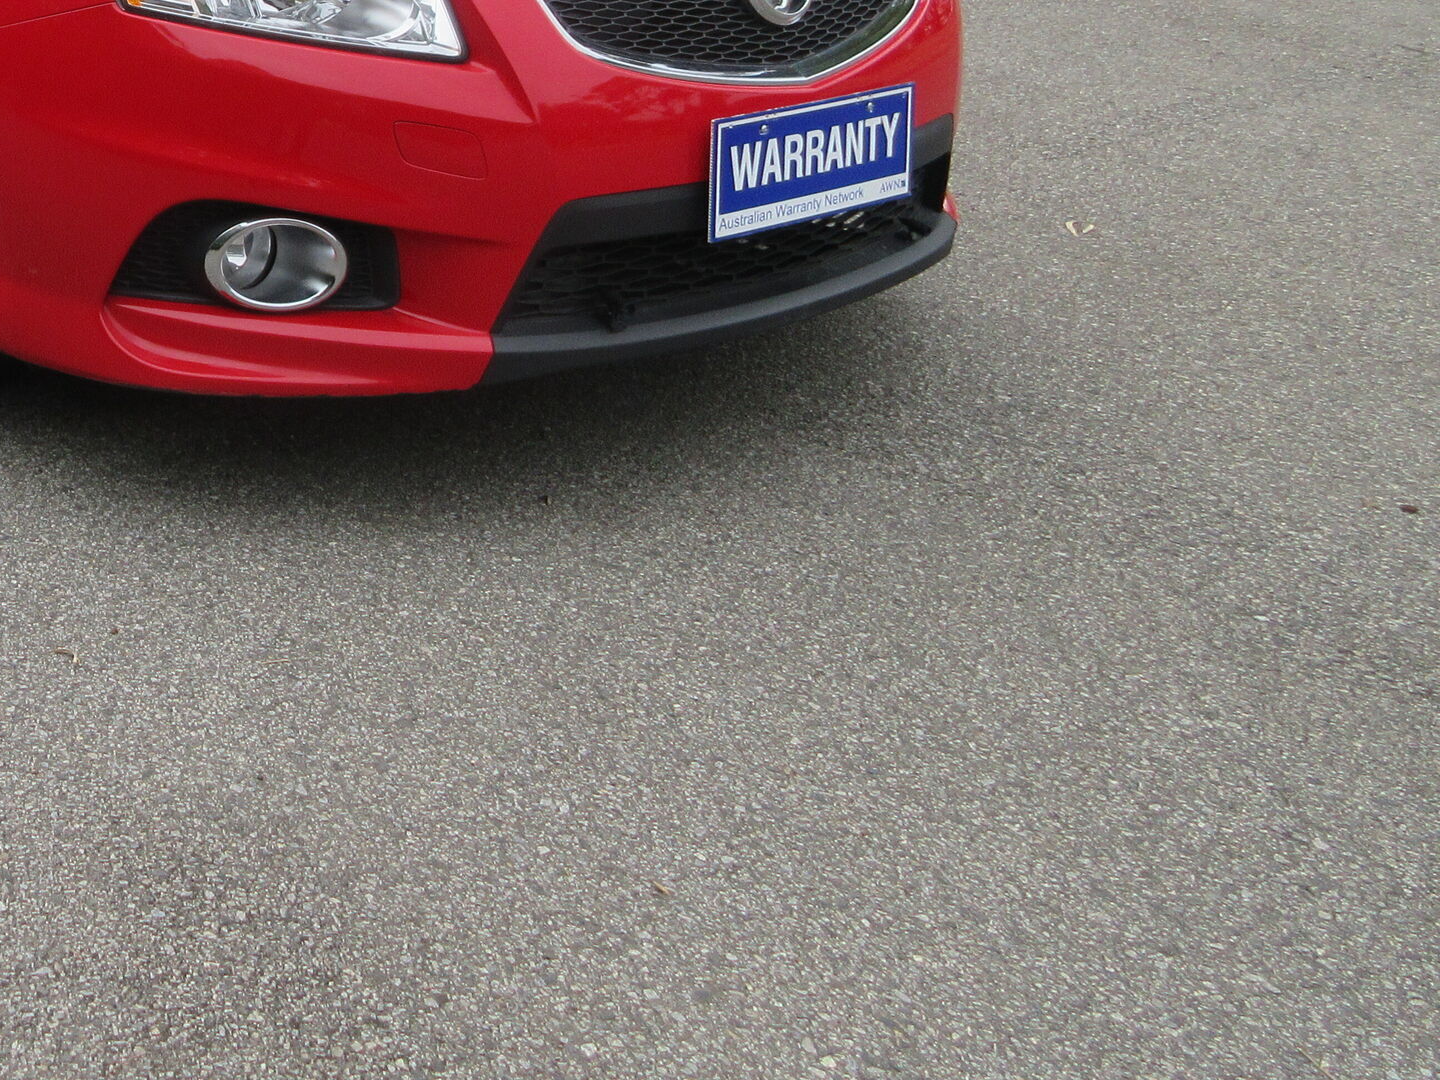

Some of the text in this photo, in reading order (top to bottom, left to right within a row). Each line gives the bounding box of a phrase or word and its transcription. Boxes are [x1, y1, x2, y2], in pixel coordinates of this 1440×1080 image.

[730, 112, 901, 192] WARRANTY
[718, 188, 864, 231] Australian Warranty Network
